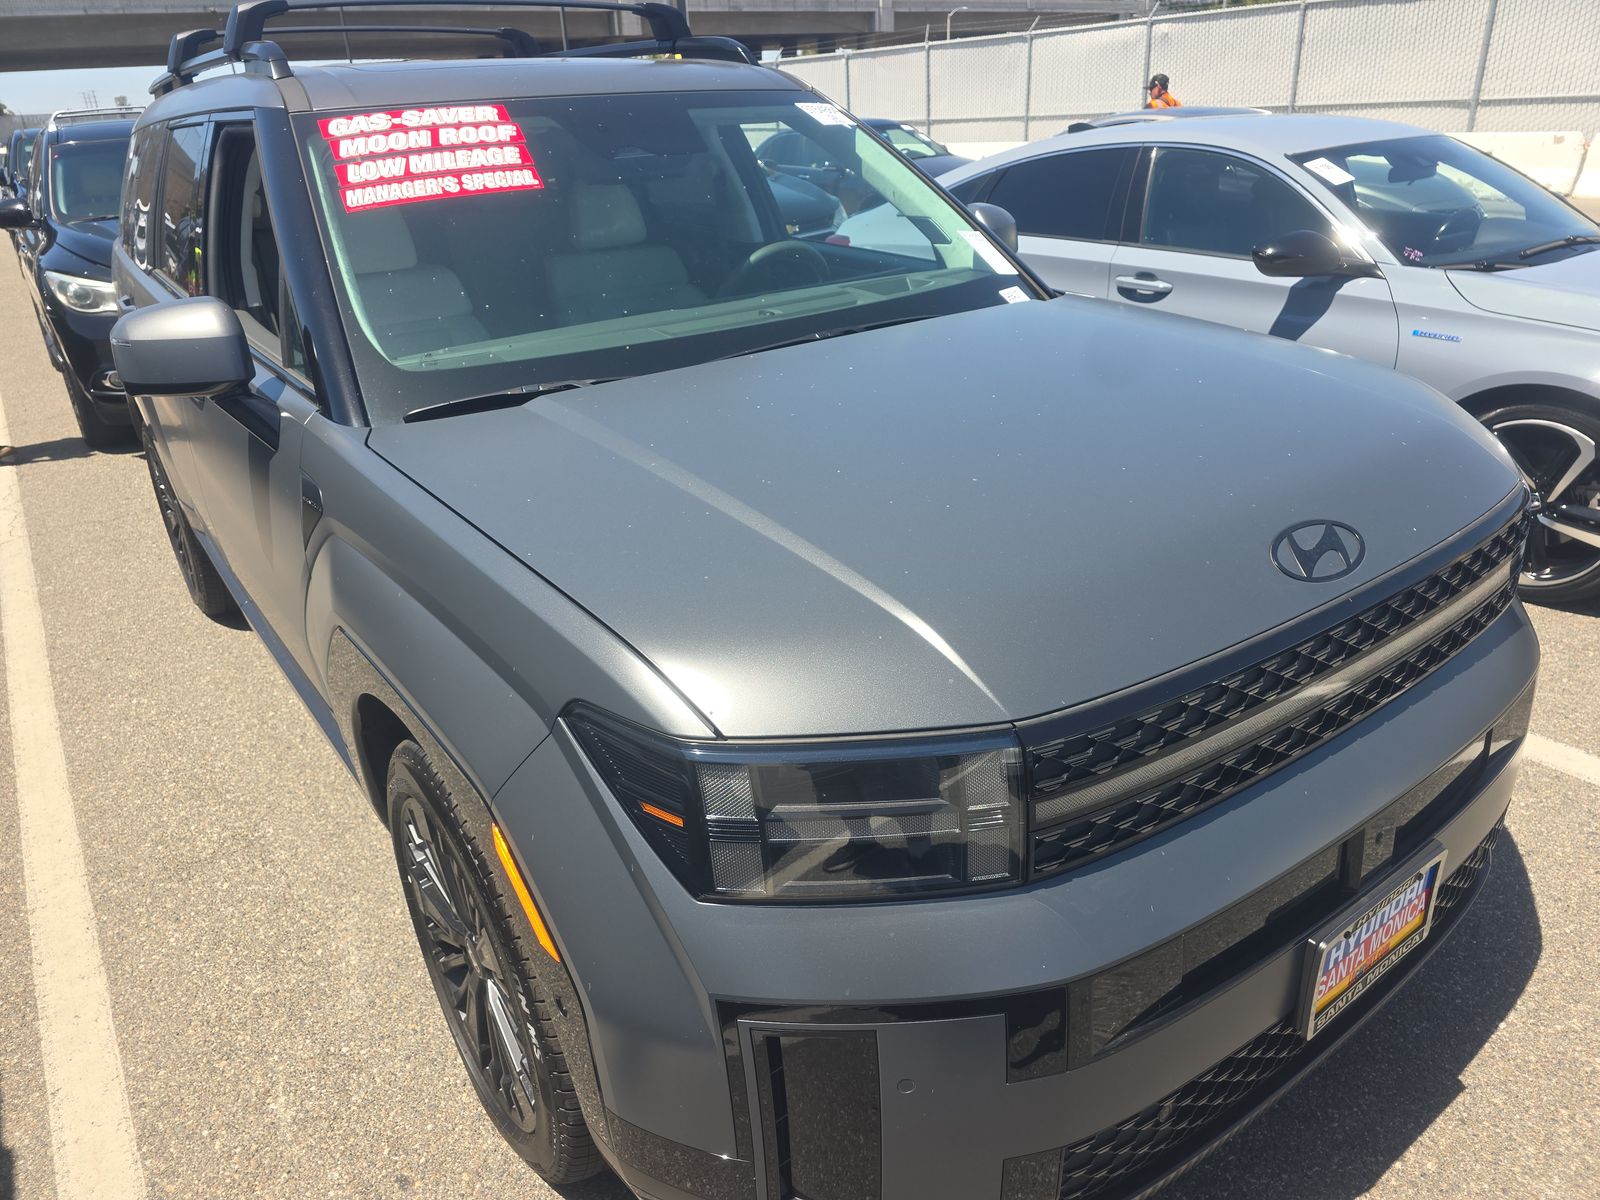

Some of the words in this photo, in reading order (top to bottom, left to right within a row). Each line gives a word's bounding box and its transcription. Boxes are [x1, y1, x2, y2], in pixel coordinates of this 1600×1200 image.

[328, 106, 499, 136] GAS-SAVER
[338, 130, 431, 158] MOON
[439, 124, 517, 146] ROOF
[347, 157, 406, 183] LOW
[408, 146, 522, 174] MILEAGE
[346, 175, 460, 208] MANAGER'S
[461, 169, 539, 192] SPECIAL
[1317, 944, 1365, 999] SANTA
[1369, 891, 1426, 956] MONICA
[1316, 982, 1364, 1029] SANTA
[1366, 935, 1420, 985] MONICA
